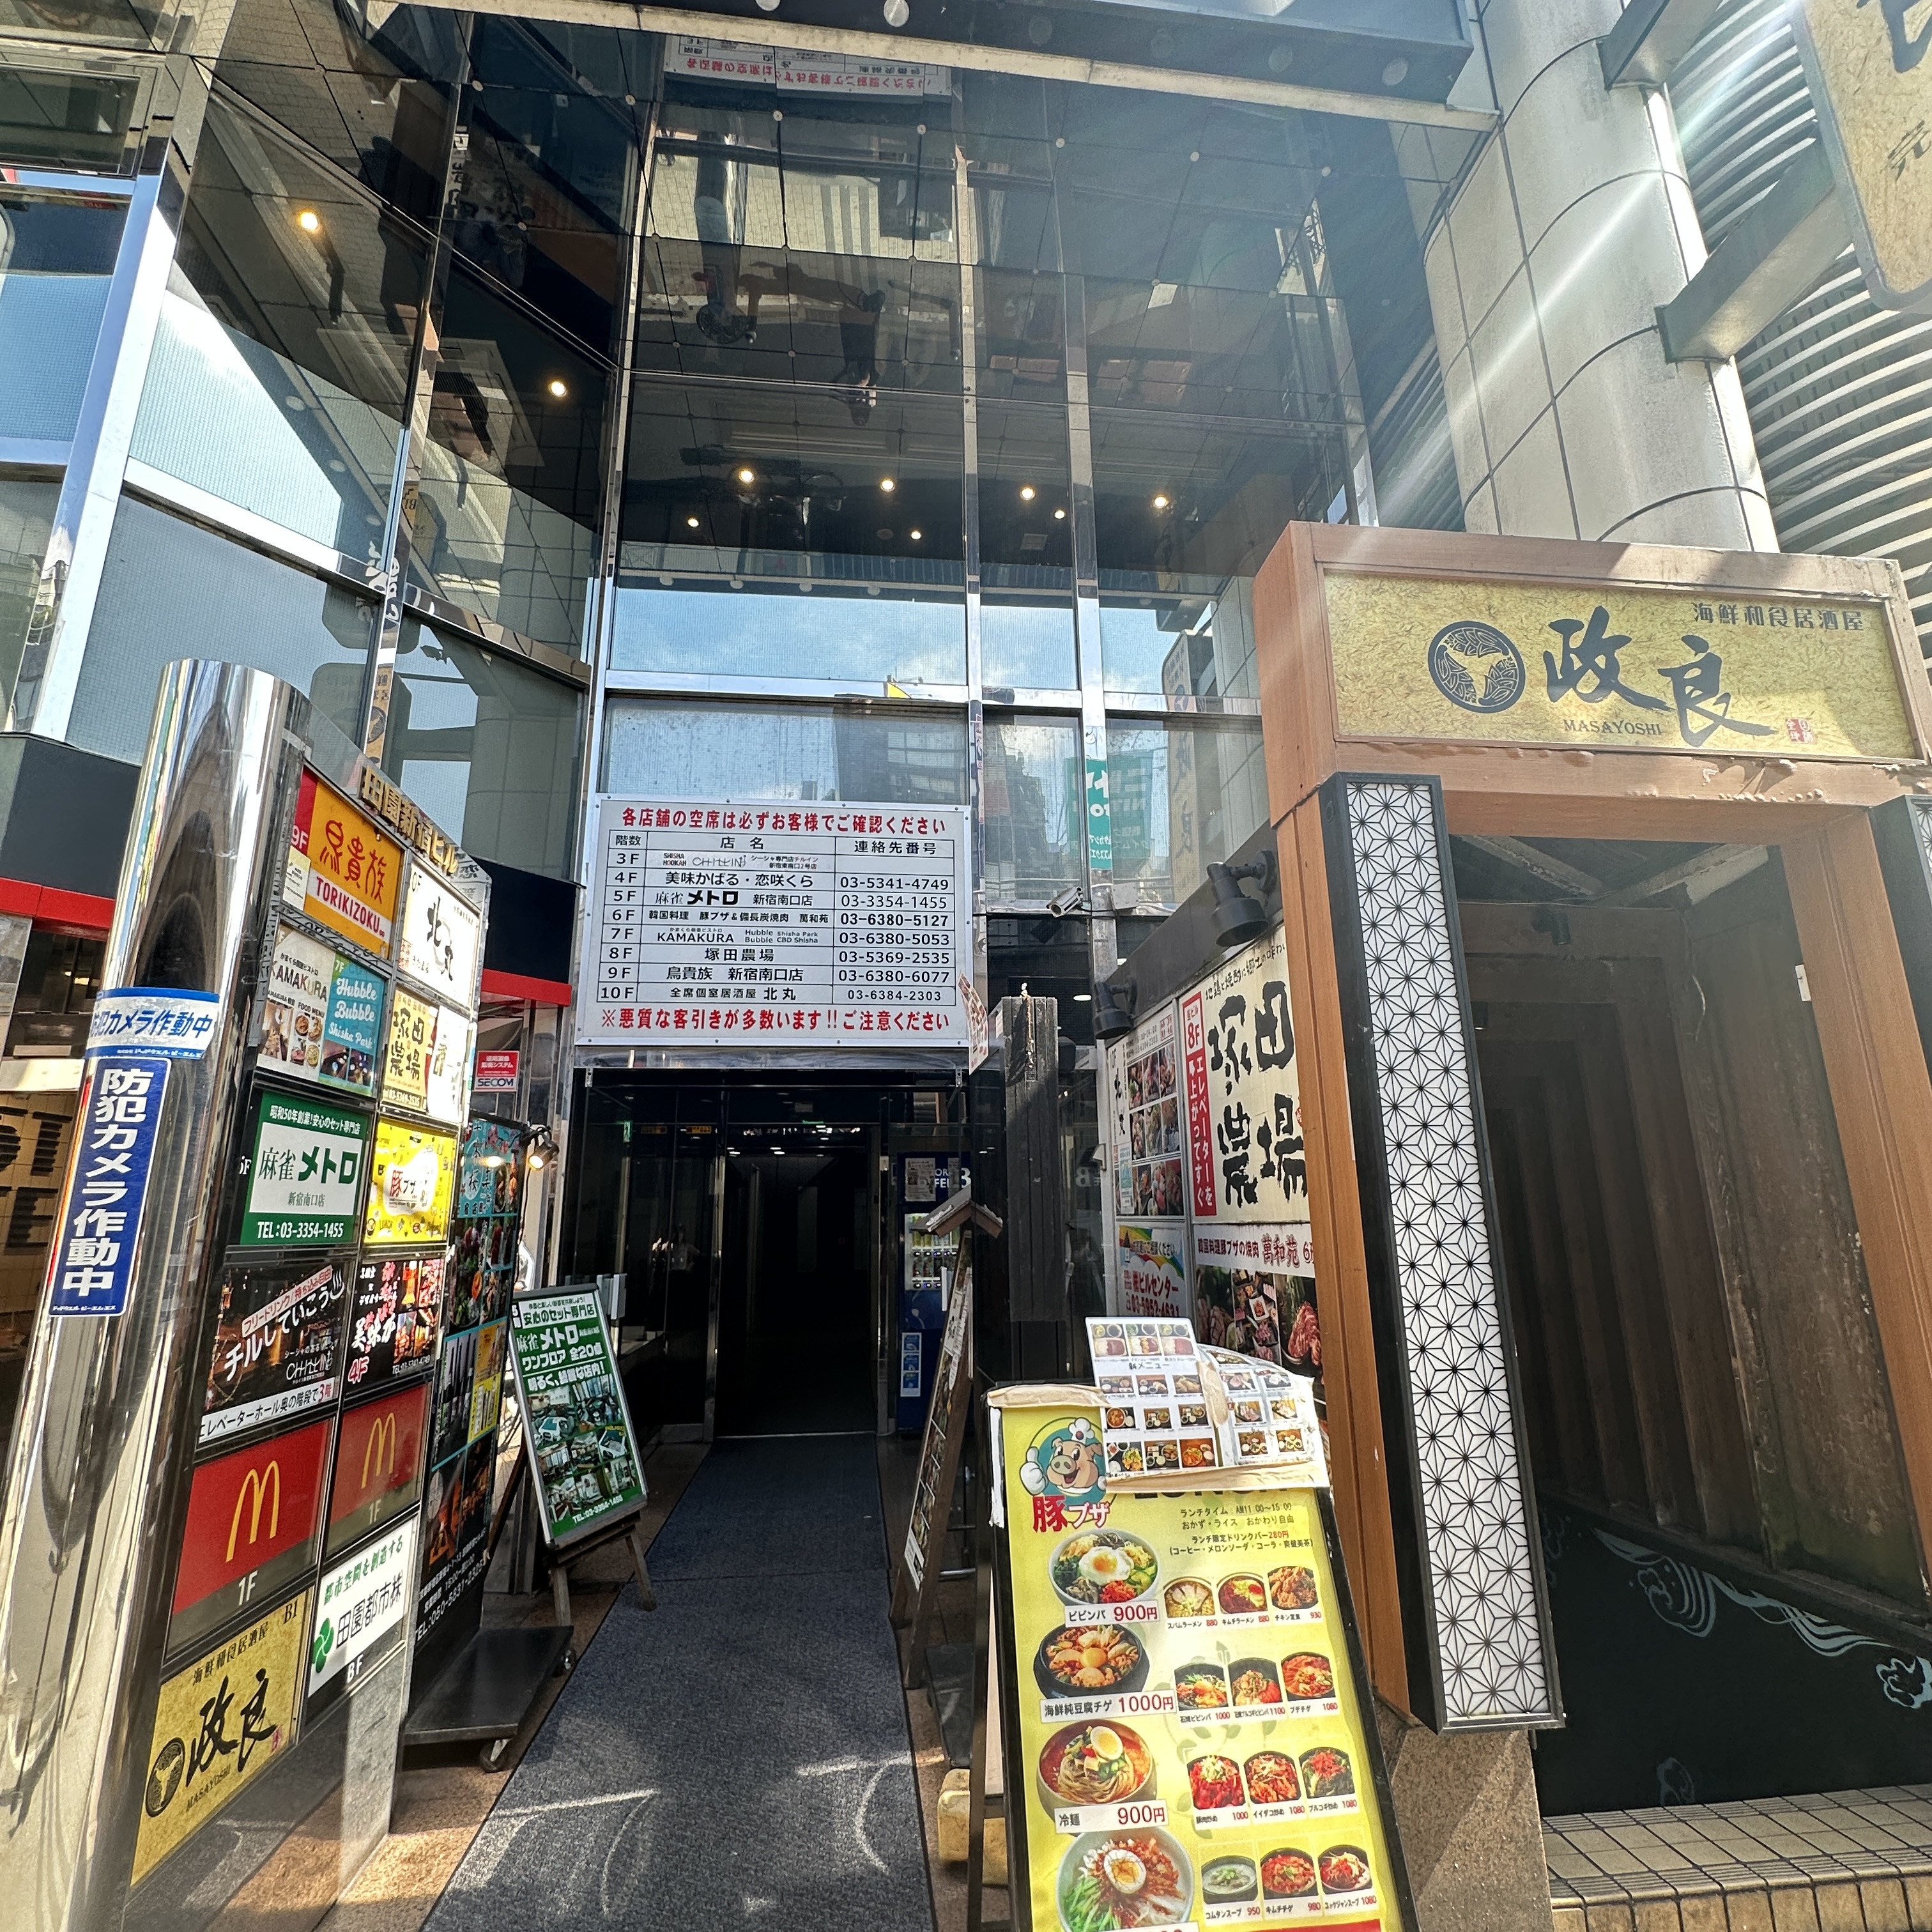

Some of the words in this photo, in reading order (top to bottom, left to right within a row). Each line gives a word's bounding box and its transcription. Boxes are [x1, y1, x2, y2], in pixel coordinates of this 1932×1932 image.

[1693, 602, 1864, 632] 海鮮和食居酒屋
[1563, 719, 1662, 737] MASAYOSHI
[622, 807, 946, 836] 各店舗の空席は必ずお客様でご確認ください
[291, 825, 309, 849] 9F
[615, 834, 641, 847] 階数
[854, 840, 937, 855] 連絡先番号
[617, 853, 640, 864] 3F
[615, 872, 638, 883] 4F
[665, 872, 813, 887] 美味かばる・恋咲くら
[840, 877, 949, 890] 03-5341-4749
[613, 891, 636, 901] 5F
[753, 894, 813, 907] 新宿南口店
[841, 894, 947, 908] 03-3354-1455
[316, 876, 381, 934] TORIKIZOKU
[613, 909, 635, 921] 6F
[840, 914, 949, 927] 03-6380-5127
[611, 928, 633, 939] 7F
[657, 933, 735, 943] KAMAKURA
[839, 932, 949, 946] 03-6380-5053
[609, 947, 632, 959] 8F
[705, 948, 774, 962] 塚田農場
[839, 951, 950, 965] 03-5369-2535
[608, 967, 631, 979] 9F
[666, 966, 713, 981] 鳥貴族
[728, 967, 804, 981] 新宿南口店
[839, 969, 950, 983] 03-6380-6077
[336, 978, 378, 1001] Hubble
[601, 987, 634, 999] 10F
[763, 987, 797, 1000] 北丸
[847, 990, 942, 1001] 03-6384-2303
[334, 1000, 375, 1022] Bubble
[1188, 1022, 1200, 1049] 8F
[477, 1078, 514, 1087] SECOM
[1195, 1055, 1213, 1208] エレベーターを
[1189, 1078, 1204, 1208] 上がってすぐ
[62, 1068, 155, 1298] 防犯カメラ作動中
[288, 1191, 325, 1208] 新宿南口店
[348, 1356, 370, 1384] 4F
[1032, 1495, 1111, 1533] 豚ブザ
[1180, 1506, 1229, 1517] ランチタイム
[1182, 1519, 1238, 1530] おかず・ライス
[1246, 1514, 1294, 1526] おかわり自由
[324, 1534, 403, 1606] 都市空間を創造する
[238, 1570, 259, 1607] 1F
[284, 1598, 298, 1624] B1
[1113, 1604, 1158, 1621] 900円
[192, 1621, 270, 1686] 海鮮和食居酒屋
[347, 1653, 364, 1683] BF
[1045, 1699, 1113, 1717] 海鮮純豆腐チゲ
[1119, 1694, 1174, 1713] 1000円
[1269, 1706, 1285, 1716] 1100
[1215, 1711, 1230, 1721] 1000
[1289, 1805, 1305, 1814] 1080
[1342, 1798, 1358, 1809] 1080
[1117, 1805, 1166, 1825] 900円
[1232, 1811, 1248, 1821] 1000
[1361, 1895, 1377, 1905] 1080
[1246, 1906, 1261, 1916] 950
[1266, 1903, 1294, 1914] キムチチゲ
[1307, 1901, 1322, 1912] 980
